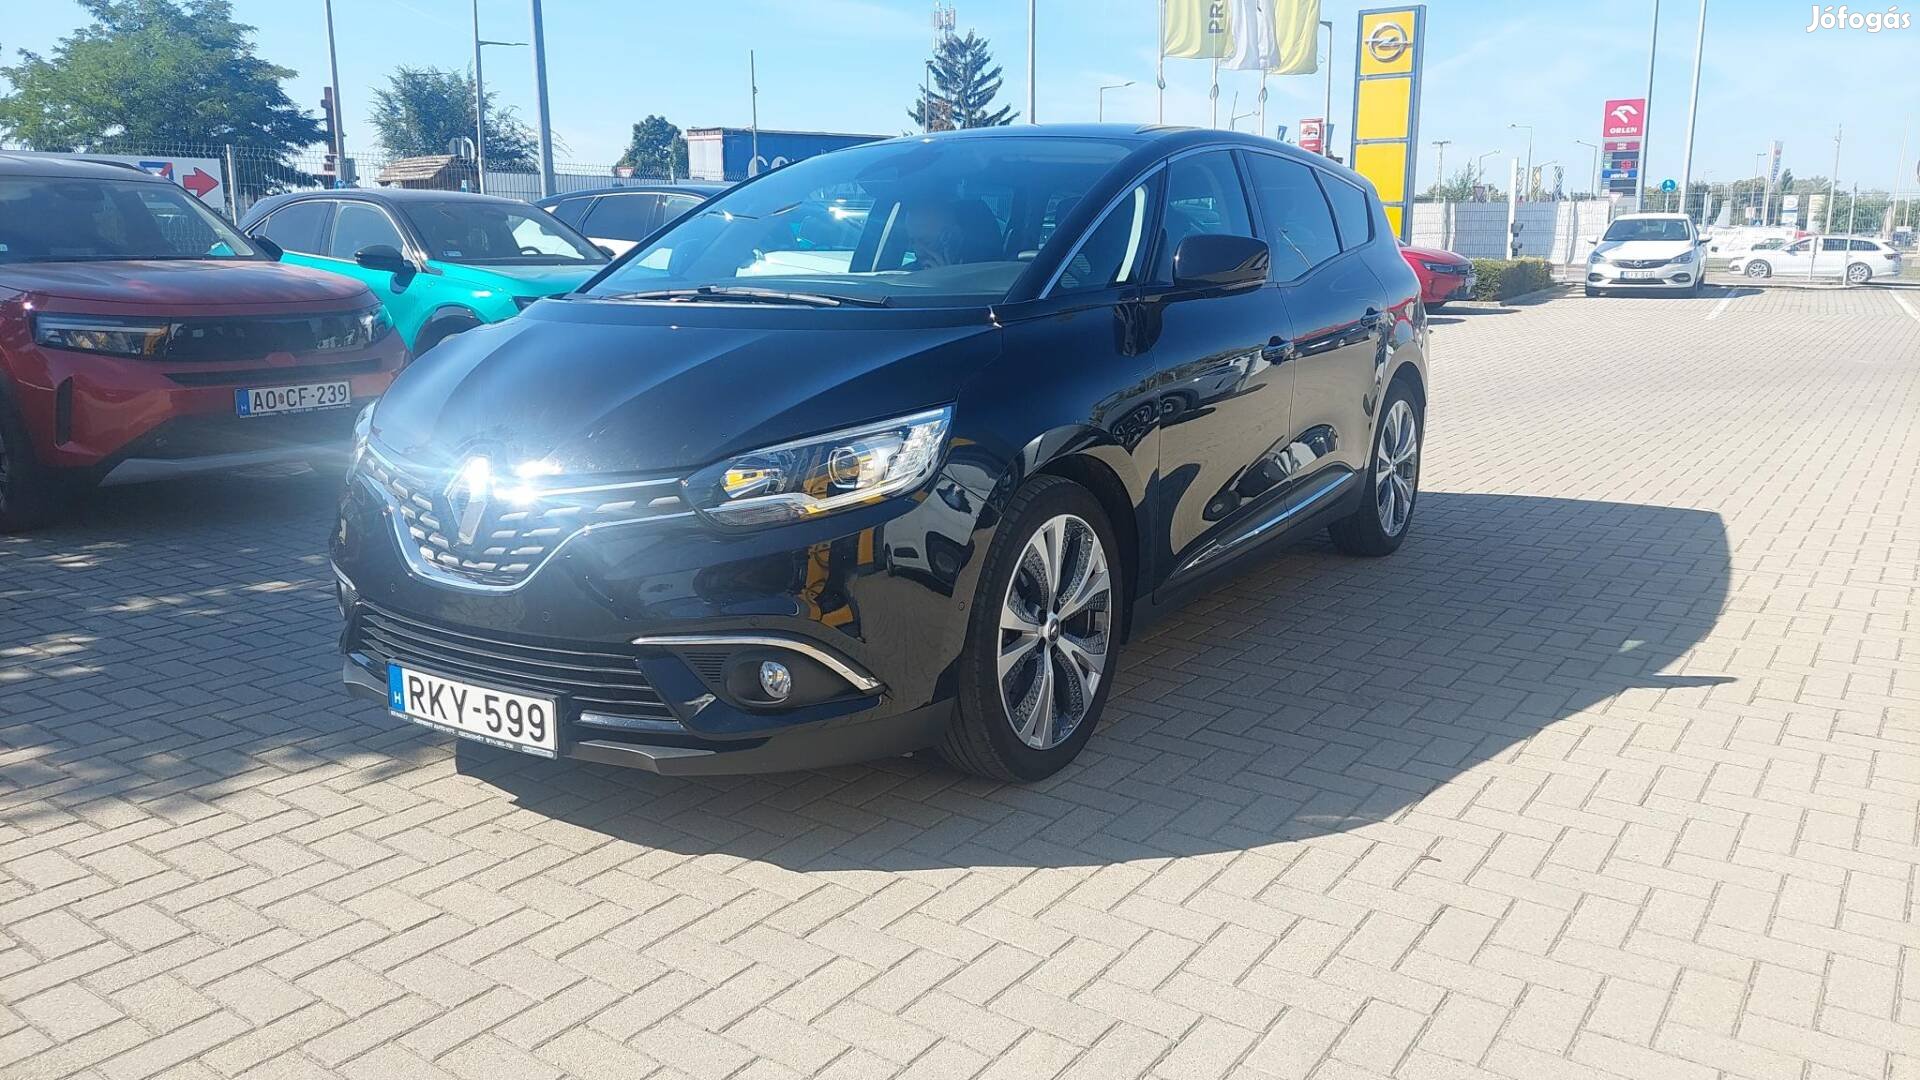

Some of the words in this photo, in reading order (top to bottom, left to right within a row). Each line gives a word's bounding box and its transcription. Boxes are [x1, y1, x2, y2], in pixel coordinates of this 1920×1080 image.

[1208, 0, 1224, 33] PR
[394, 691, 402, 704] H
[408, 675, 545, 742] RKY-599
